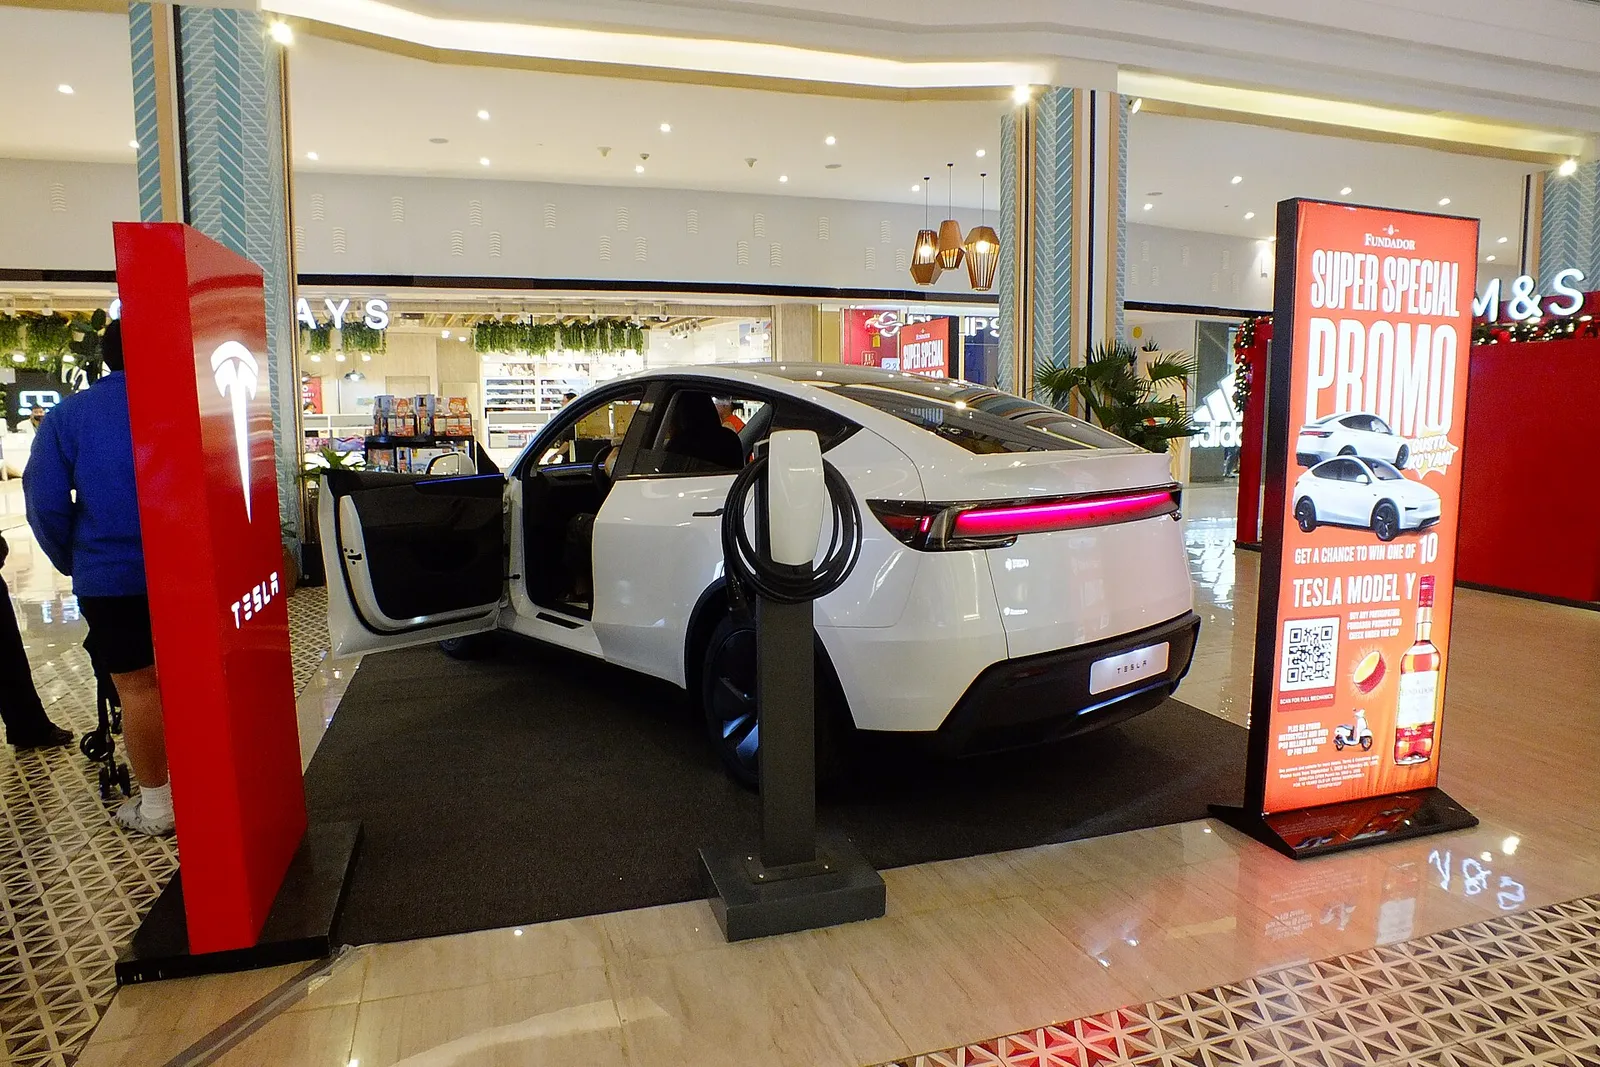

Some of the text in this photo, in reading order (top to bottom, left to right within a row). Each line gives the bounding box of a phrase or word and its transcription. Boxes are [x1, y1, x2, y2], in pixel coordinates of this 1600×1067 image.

[1364, 233, 1416, 250] FUNDADOR
[1310, 249, 1460, 317] SUPER SPECIAL
[1305, 317, 1458, 438] PROMO
[1294, 532, 1438, 565] GET A CHANCE TO WIN ONE OF 10
[231, 571, 279, 629] TESLA
[1293, 572, 1417, 608] TESLA MODEL Y
[1117, 660, 1147, 674] TESLA
